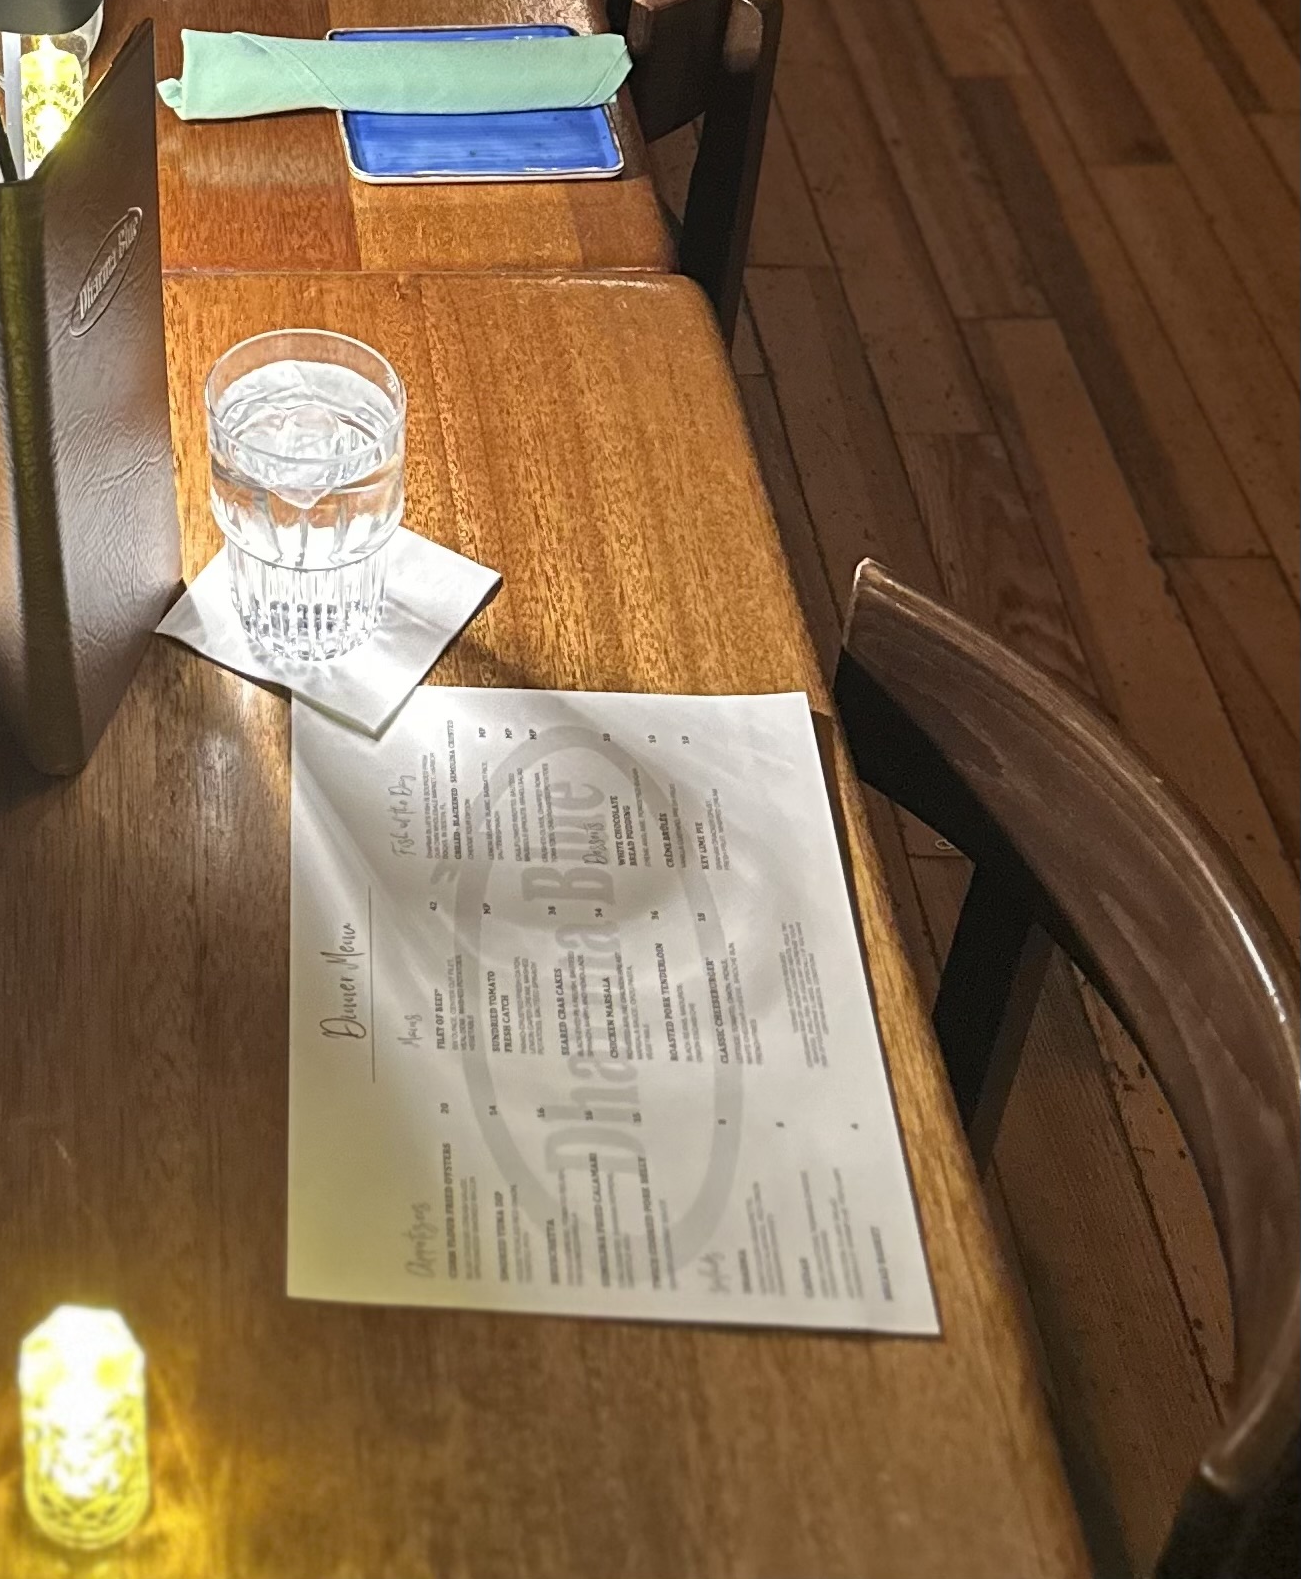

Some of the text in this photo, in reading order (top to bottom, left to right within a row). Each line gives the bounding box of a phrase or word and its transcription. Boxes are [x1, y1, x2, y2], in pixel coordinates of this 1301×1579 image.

[447, 720, 455, 748] CRUSTED
[479, 727, 486, 738] MP
[505, 728, 512, 739] MP
[529, 729, 537, 740] MP
[648, 735, 656, 743] 10
[449, 750, 457, 783] SEMOLINA
[451, 788, 460, 826] BLACKENED
[520, 781, 615, 905] Blue
[610, 795, 625, 866] WHITE CHOCOLATE
[623, 806, 637, 866] BREAD PUDDING
[695, 822, 709, 870] KEY LIME PIE
[430, 902, 437, 911] 42
[483, 903, 491, 915] MP
[320, 923, 366, 1039] Dinner Menu
[436, 1014, 444, 1025] OF
[488, 971, 500, 1052] SUNDRIED TOMATO
[554, 968, 570, 1056] SEARED CRAB CAKES
[602, 977, 618, 1058] CHICKEN MARSALA
[655, 943, 678, 1062] ROASTED PORK TENDERLOIN
[436, 1026, 445, 1049] FILET
[501, 995, 512, 1053] FRESH CATCH
[539, 919, 643, 1176] Dharma
[715, 1028, 728, 1064] CLASSIC
[440, 1103, 449, 1114] 20
